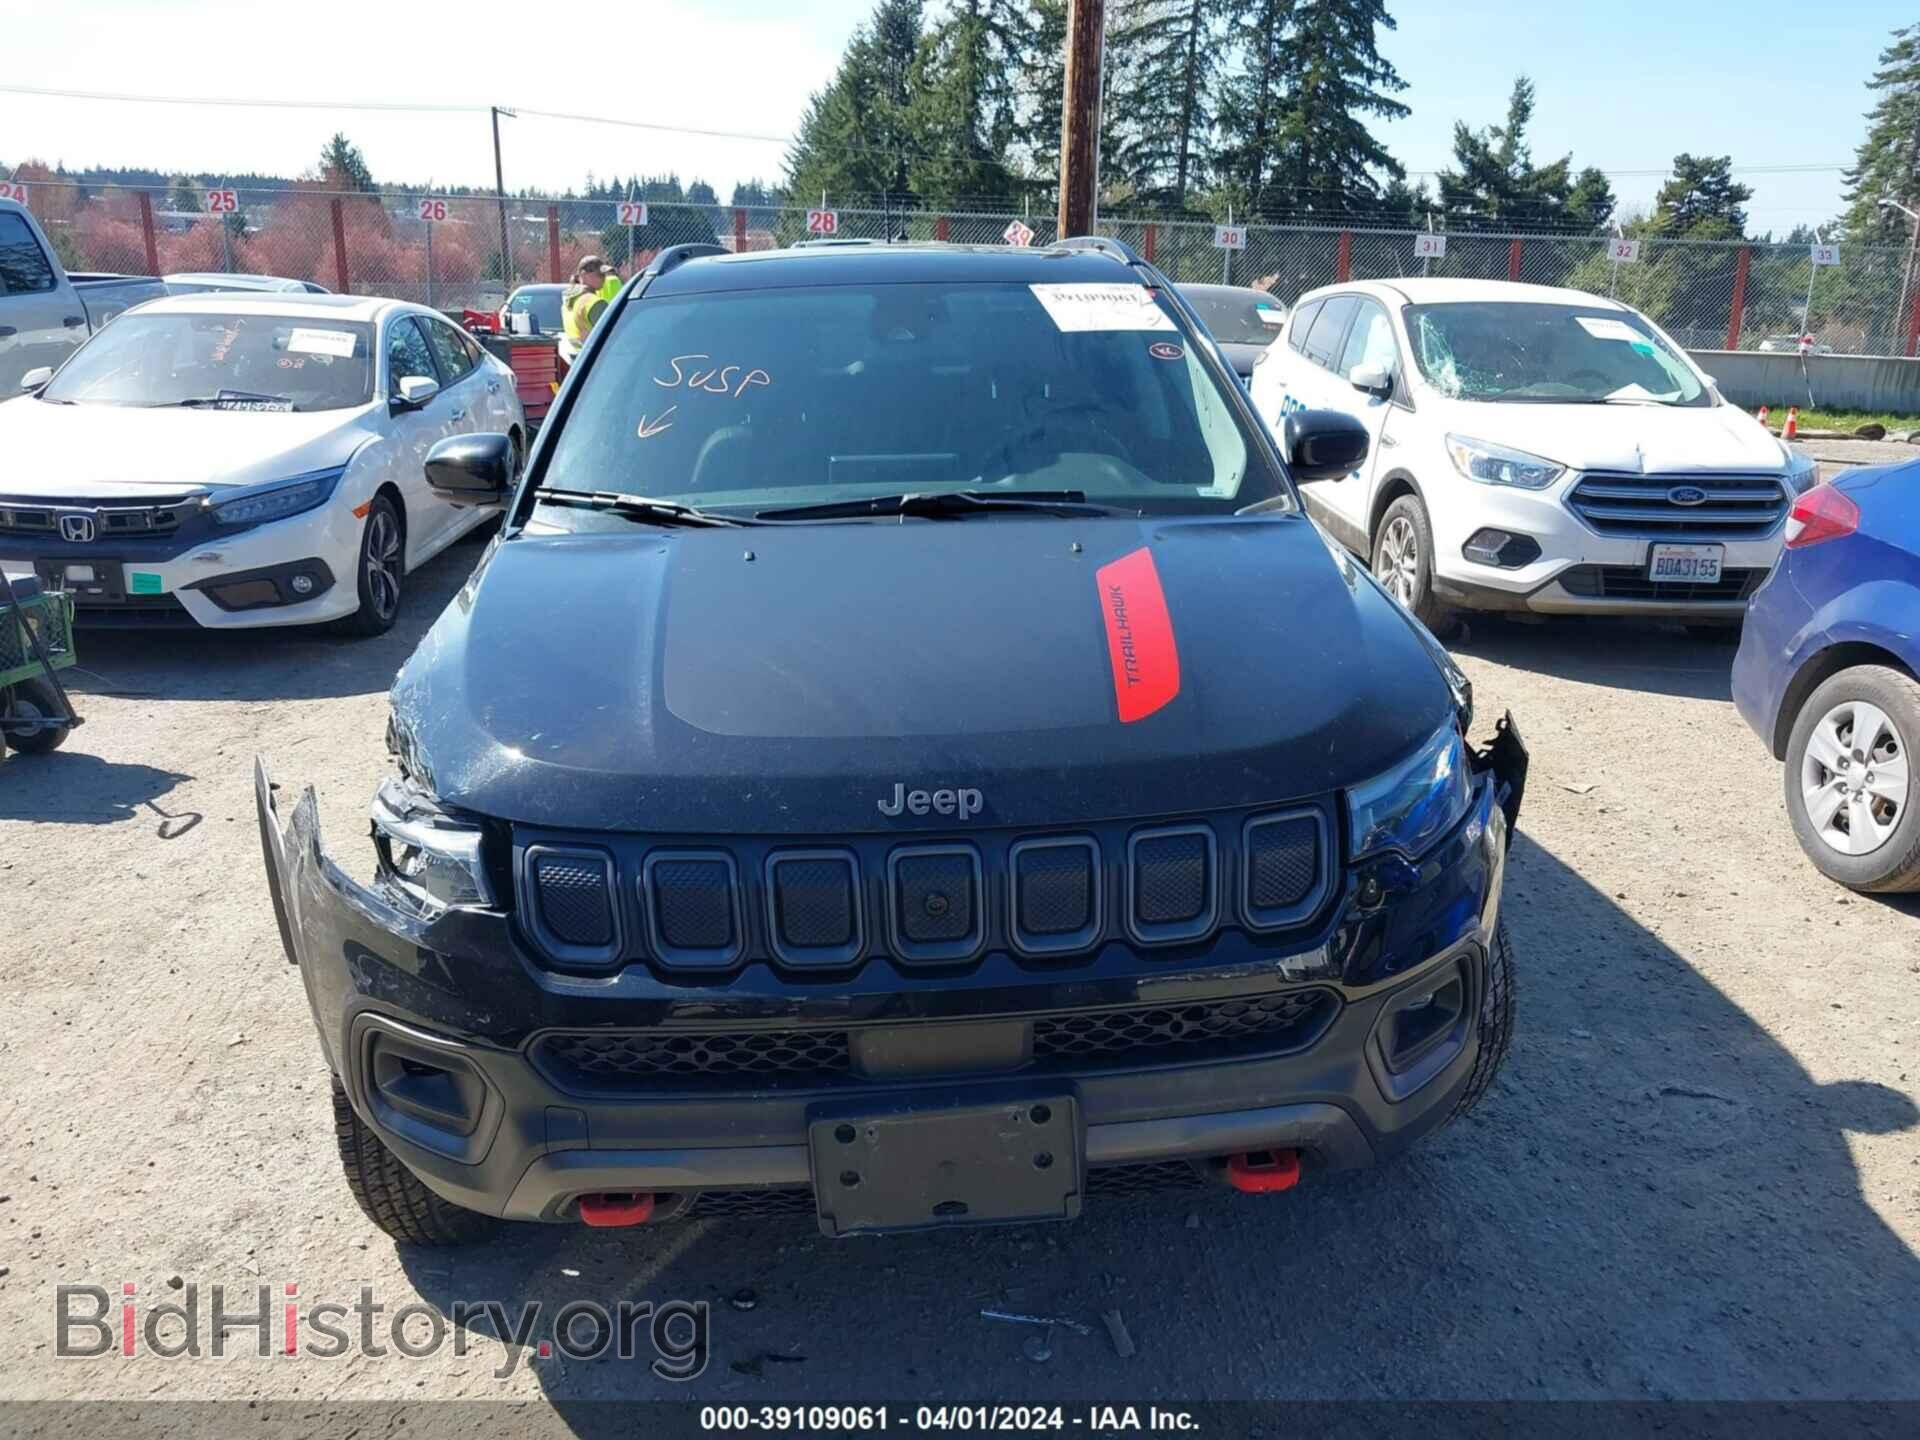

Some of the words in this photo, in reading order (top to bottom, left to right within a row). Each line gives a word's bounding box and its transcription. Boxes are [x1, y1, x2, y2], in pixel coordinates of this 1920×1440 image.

[209, 191, 236, 211] 25
[420, 200, 446, 220] 26
[622, 204, 642, 224] 27
[810, 211, 835, 232] 28
[1222, 231, 1238, 244] 30
[1423, 240, 1438, 253] 31
[1616, 245, 1631, 257] 32
[653, 354, 771, 398] SUSP
[1656, 557, 1718, 577] BDA3155
[1110, 585, 1141, 689] TRAILHAWK
[877, 782, 984, 820] Jeep
